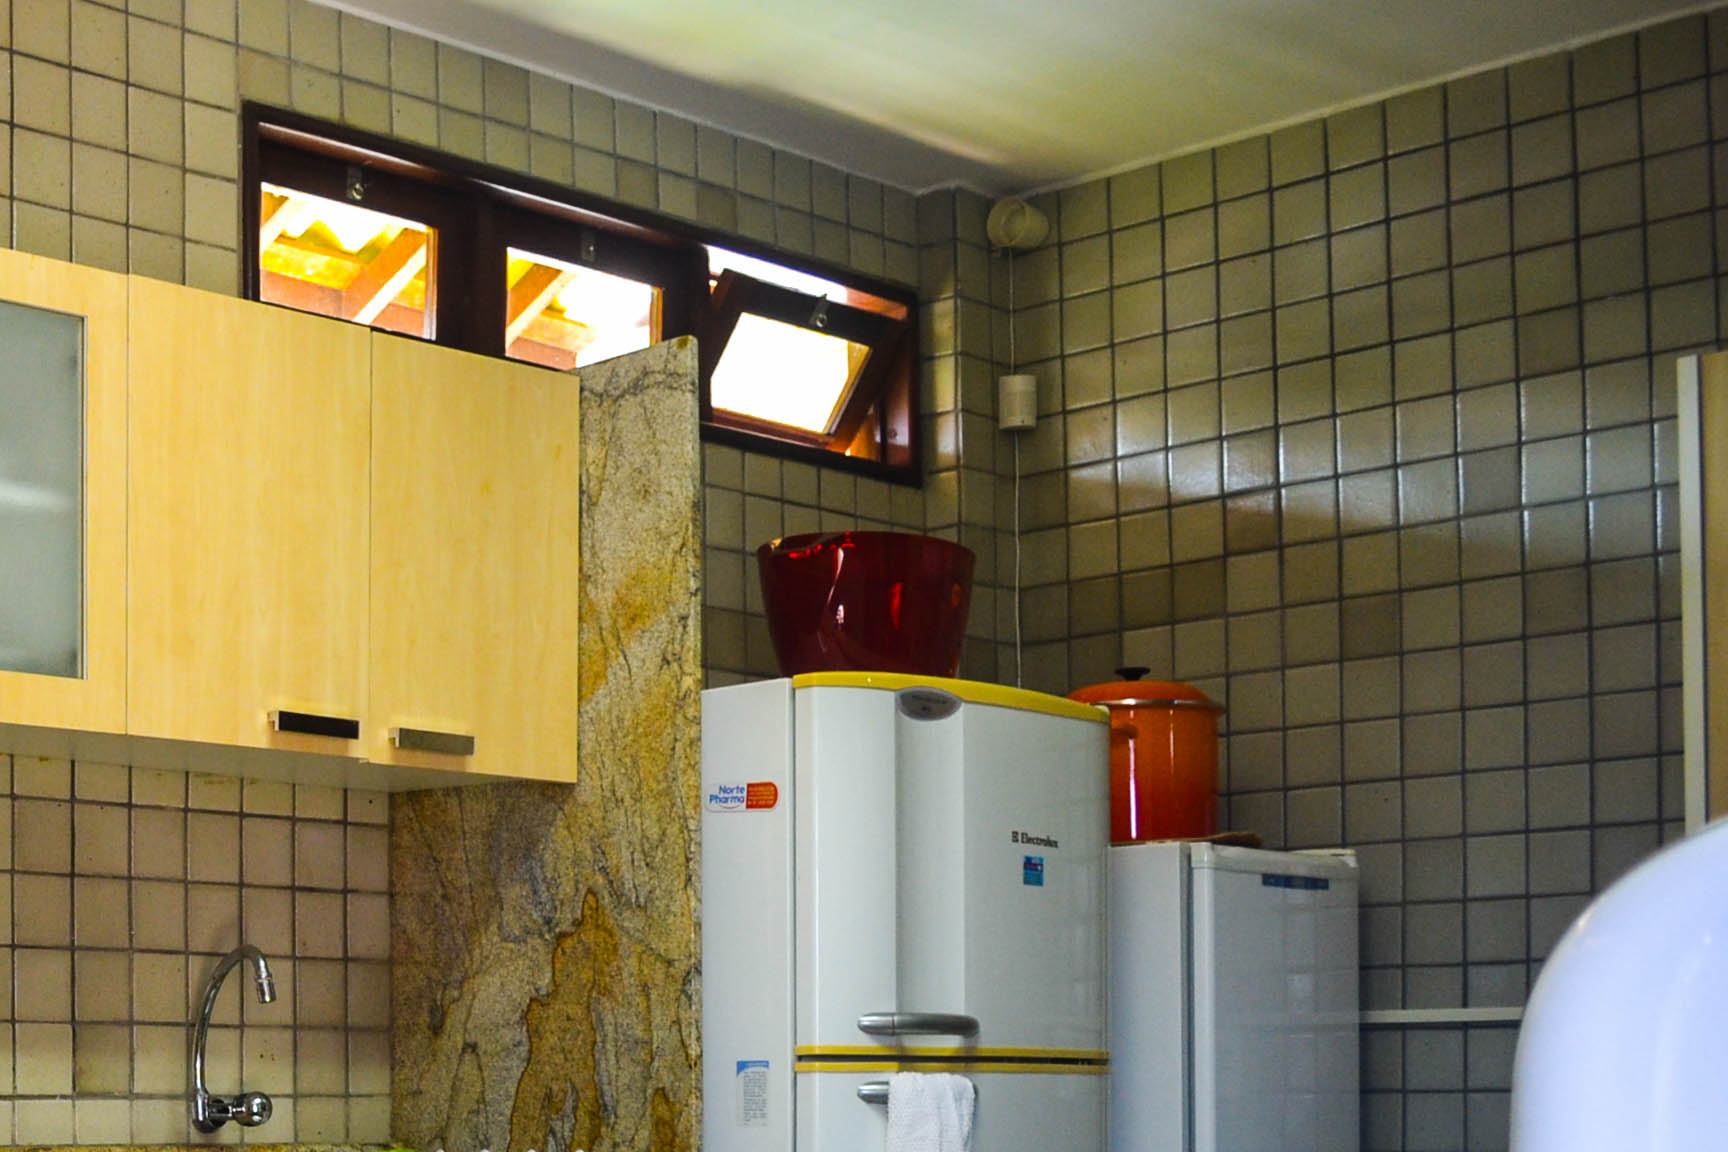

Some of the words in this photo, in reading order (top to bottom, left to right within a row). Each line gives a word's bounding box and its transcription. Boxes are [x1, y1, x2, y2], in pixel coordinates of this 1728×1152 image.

[719, 785, 745, 794] Norte
[709, 795, 744, 804] Pharma
[1021, 832, 1058, 848] Electrolux
